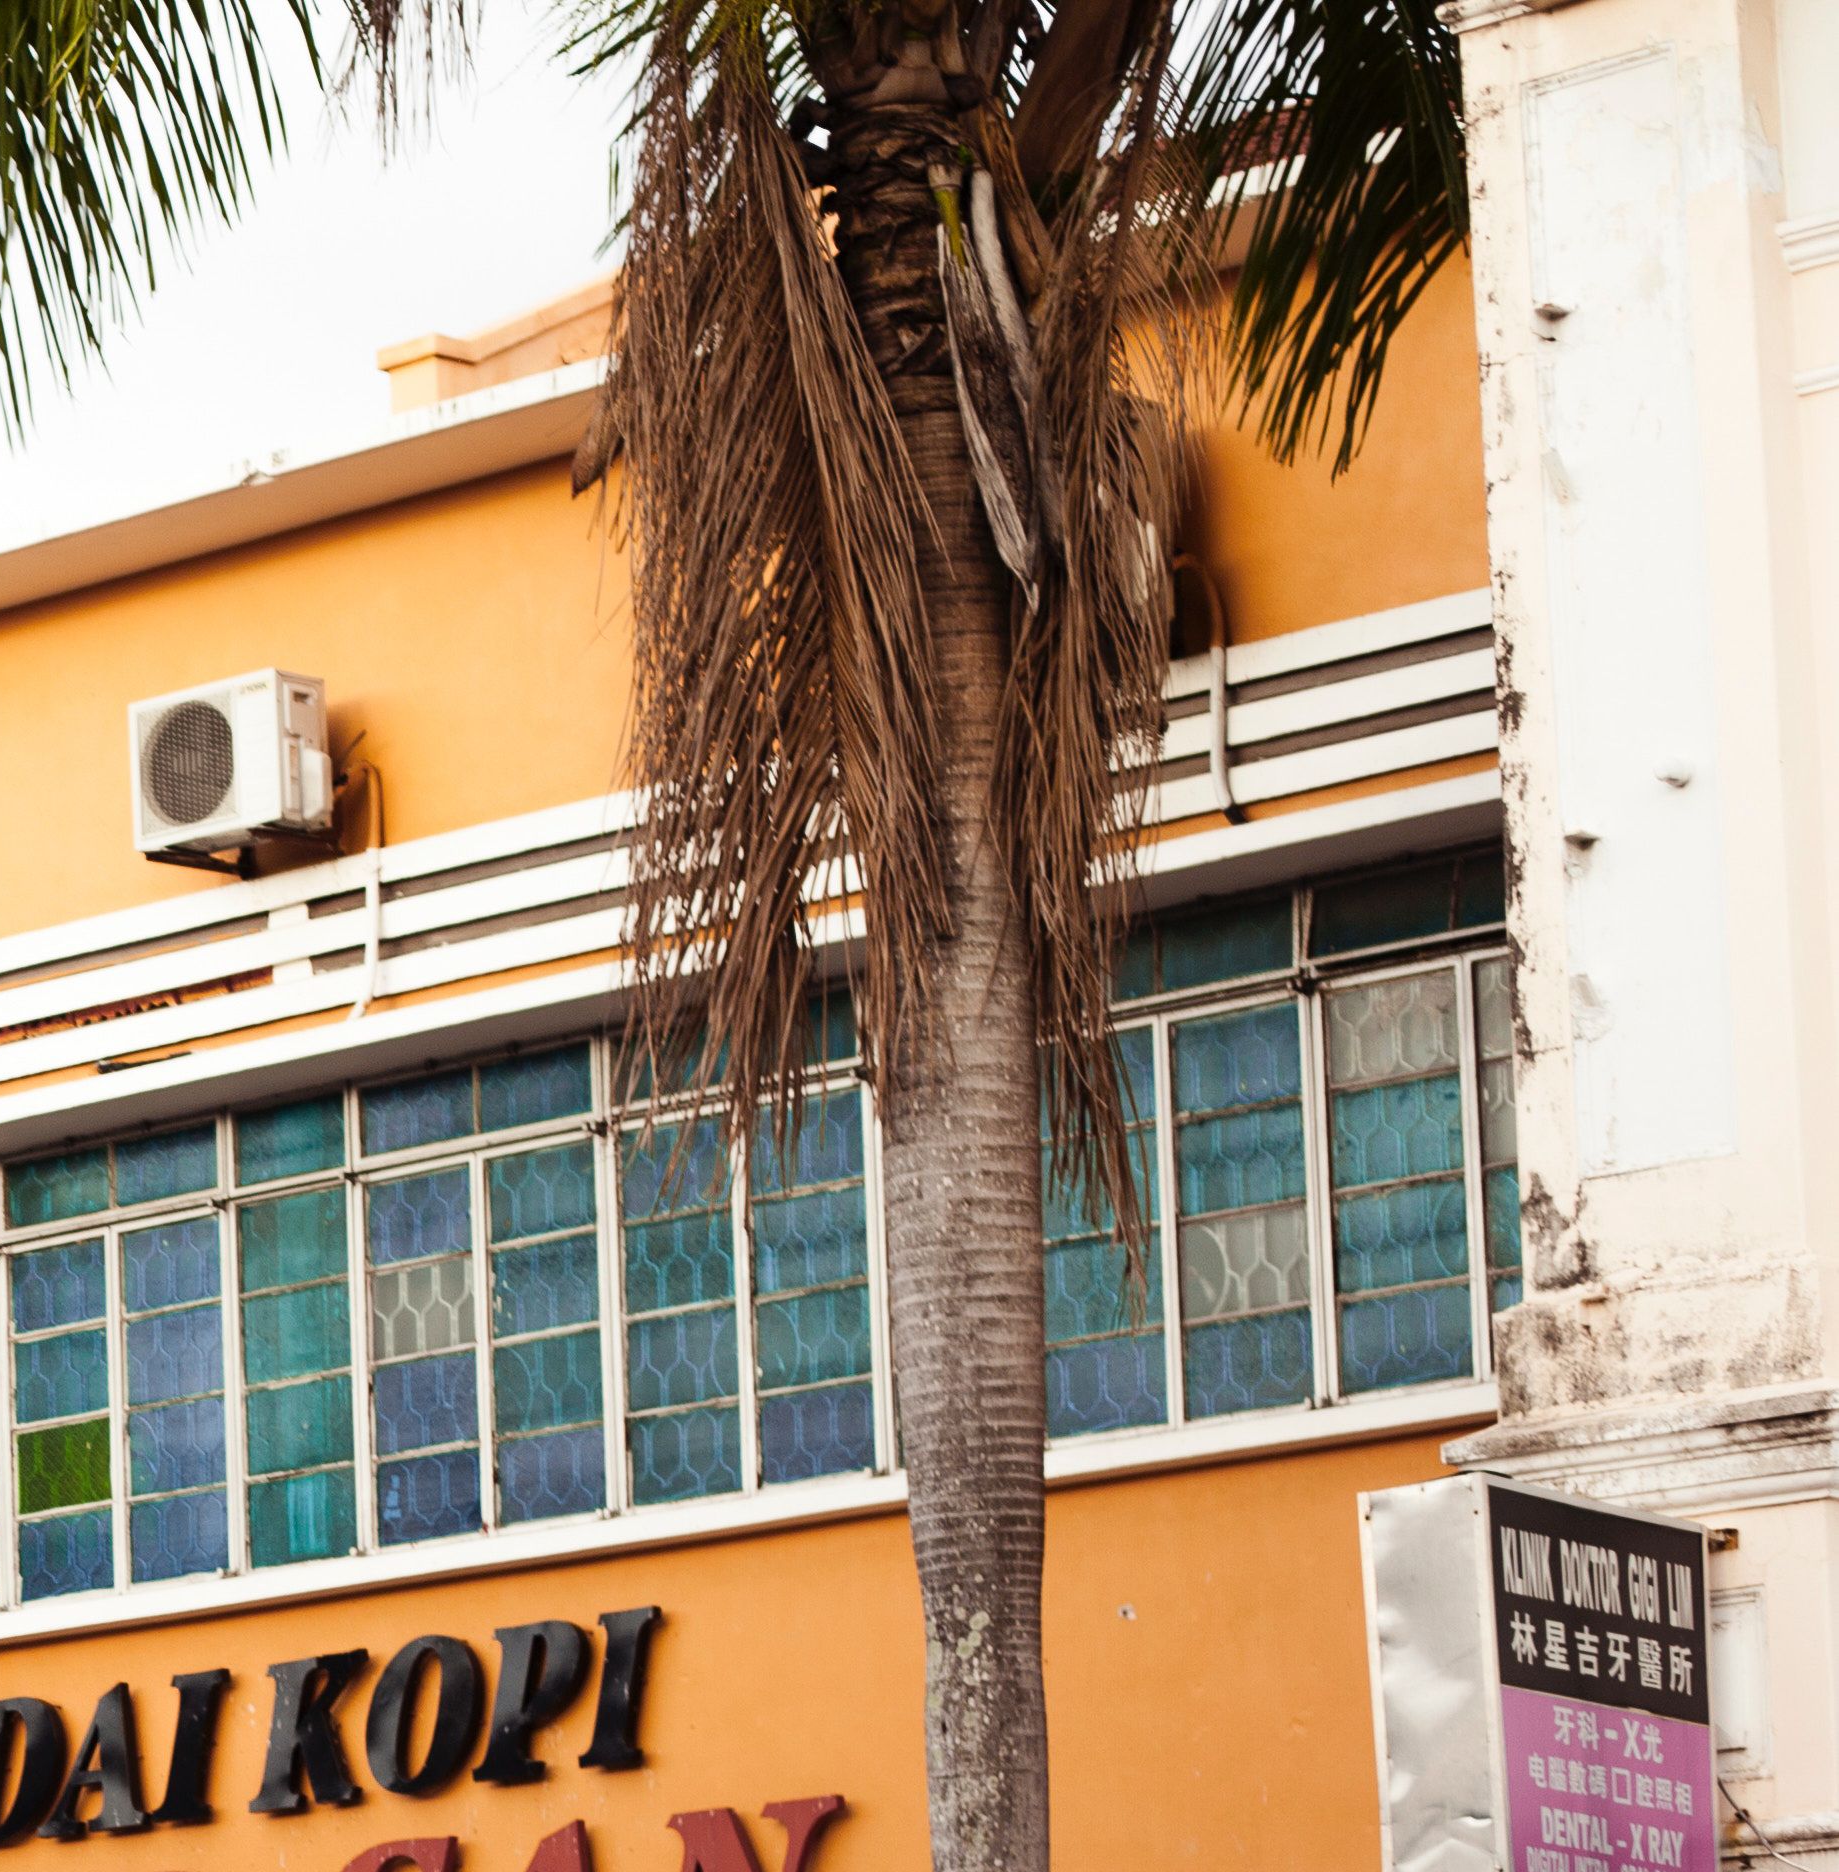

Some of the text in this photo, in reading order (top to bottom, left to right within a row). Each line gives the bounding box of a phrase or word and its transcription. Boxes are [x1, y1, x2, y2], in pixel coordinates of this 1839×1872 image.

[1500, 1526, 1694, 1630] KLINIK DOKTOR GIGI LIM
[1510, 1610, 1694, 1696] 林星吉牙醫所
[249, 1606, 662, 1814] KOPI
[1540, 1805, 1613, 1855] DENTAL
[1630, 1823, 1645, 1861] X
[1648, 1826, 1684, 1868] RAY
